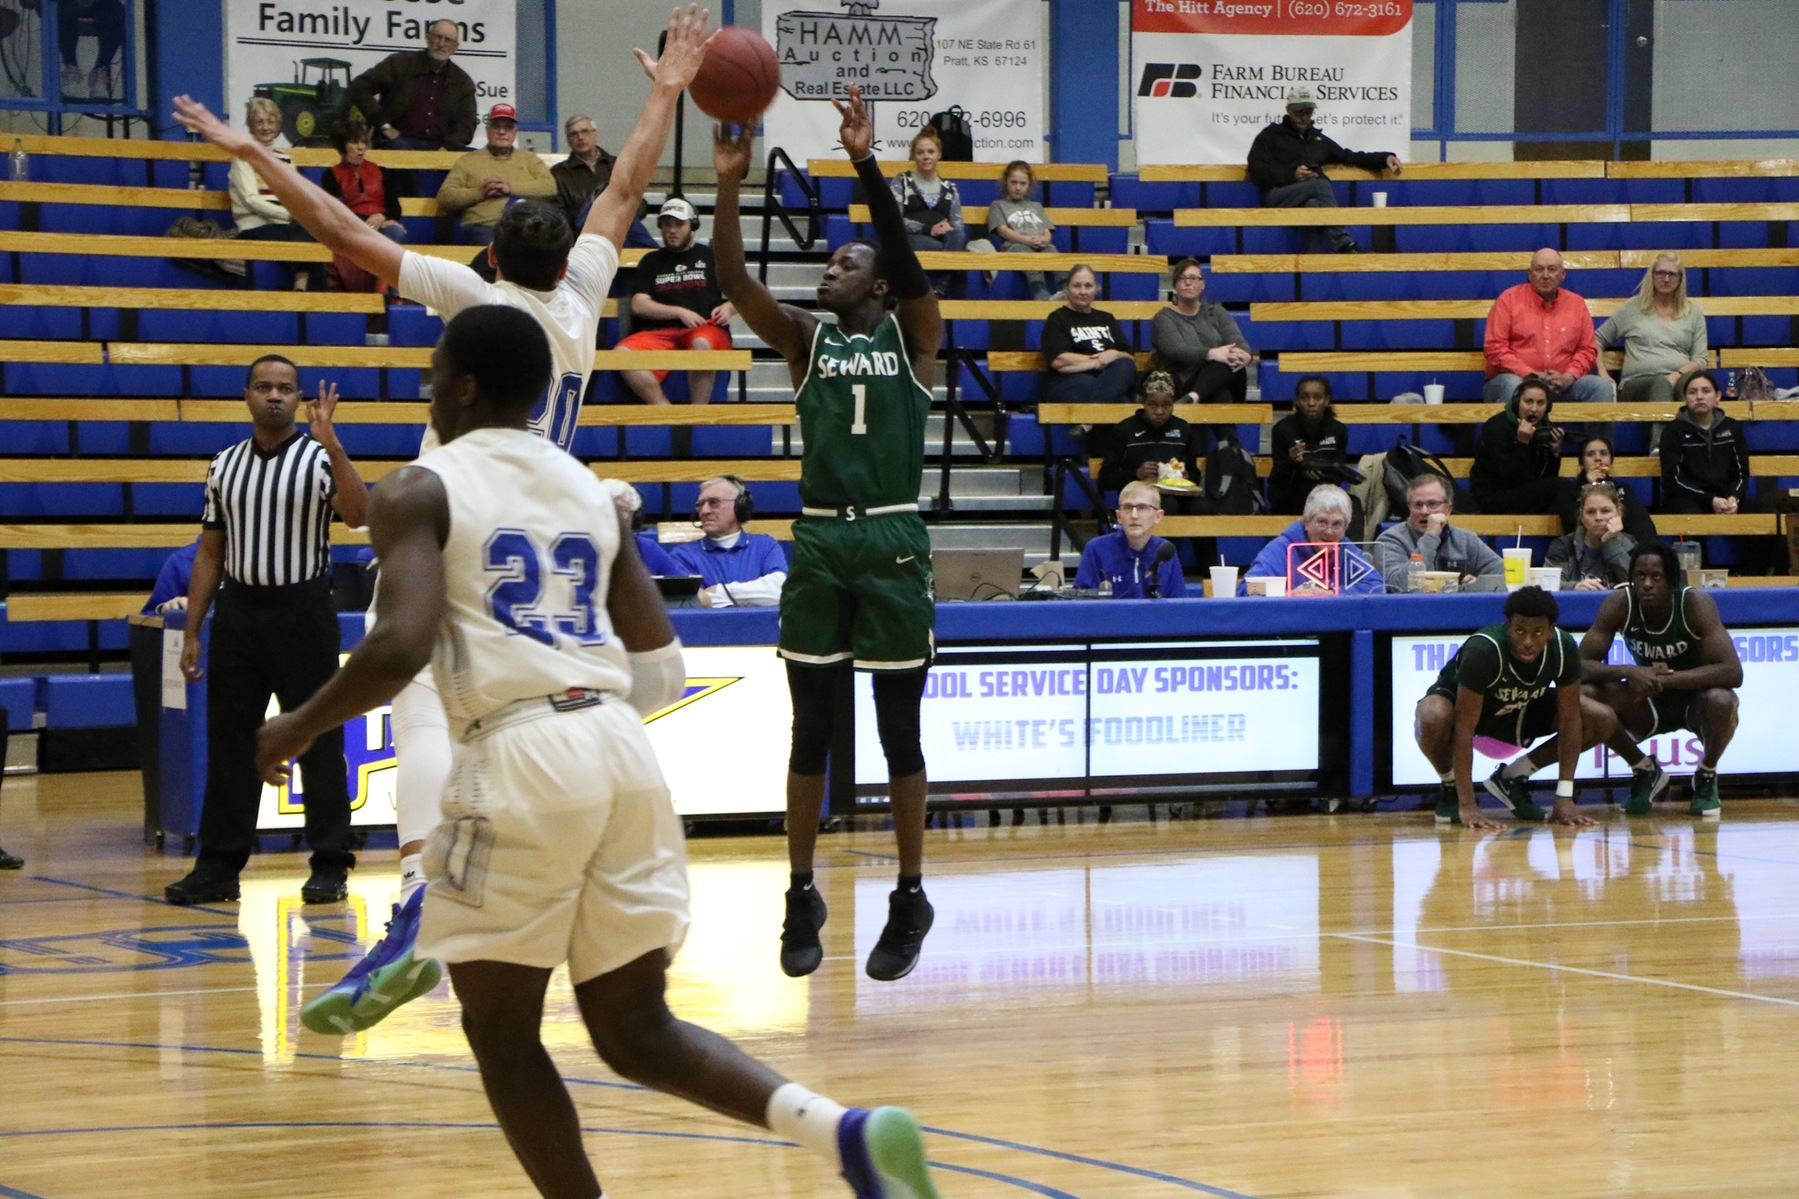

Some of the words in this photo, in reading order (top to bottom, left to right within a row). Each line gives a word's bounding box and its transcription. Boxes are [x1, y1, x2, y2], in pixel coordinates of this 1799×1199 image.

[1145, 0, 1174, 13] The
[1178, 0, 1209, 14] Hitt
[1213, 1, 1272, 18] Agency
[1287, 1, 1330, 19] (620)
[1335, 1, 1402, 18] 672-3161
[258, 3, 371, 45] Family
[800, 21, 902, 46] HAMM
[937, 39, 954, 50] 107
[958, 39, 973, 50] NE
[976, 39, 1002, 51] State
[1005, 39, 1020, 51] Rd
[1023, 39, 1036, 50] 61
[784, 47, 922, 63] Auction
[943, 55, 970, 67] Pratt,
[974, 56, 989, 67] KS
[994, 56, 1028, 67] 67124
[836, 64, 870, 78] and
[1211, 63, 1264, 82] FARM
[1272, 64, 1345, 82] BUREAU
[477, 80, 509, 99] Sue
[795, 81, 829, 95] Real
[832, 81, 880, 96] Esate
[883, 82, 914, 96] LLC
[1211, 82, 1297, 100] FINANCI
[1316, 84, 1399, 101] SERVICES
[1211, 111, 1230, 125] It's
[1233, 114, 1261, 126] your
[1342, 112, 1388, 127] protect
[817, 351, 899, 379] SEWARD
[850, 384, 867, 435] 1
[482, 527, 607, 650] 23
[1629, 639, 1689, 660] SEWARD
[1732, 635, 1799, 663] SORS
[980, 669, 1086, 698] SERVICE
[1097, 668, 1148, 695] DAY
[1154, 664, 1299, 694] SPONSORS:
[951, 718, 1076, 751] WHITE'S
[1083, 713, 1246, 748] FOODLINER
